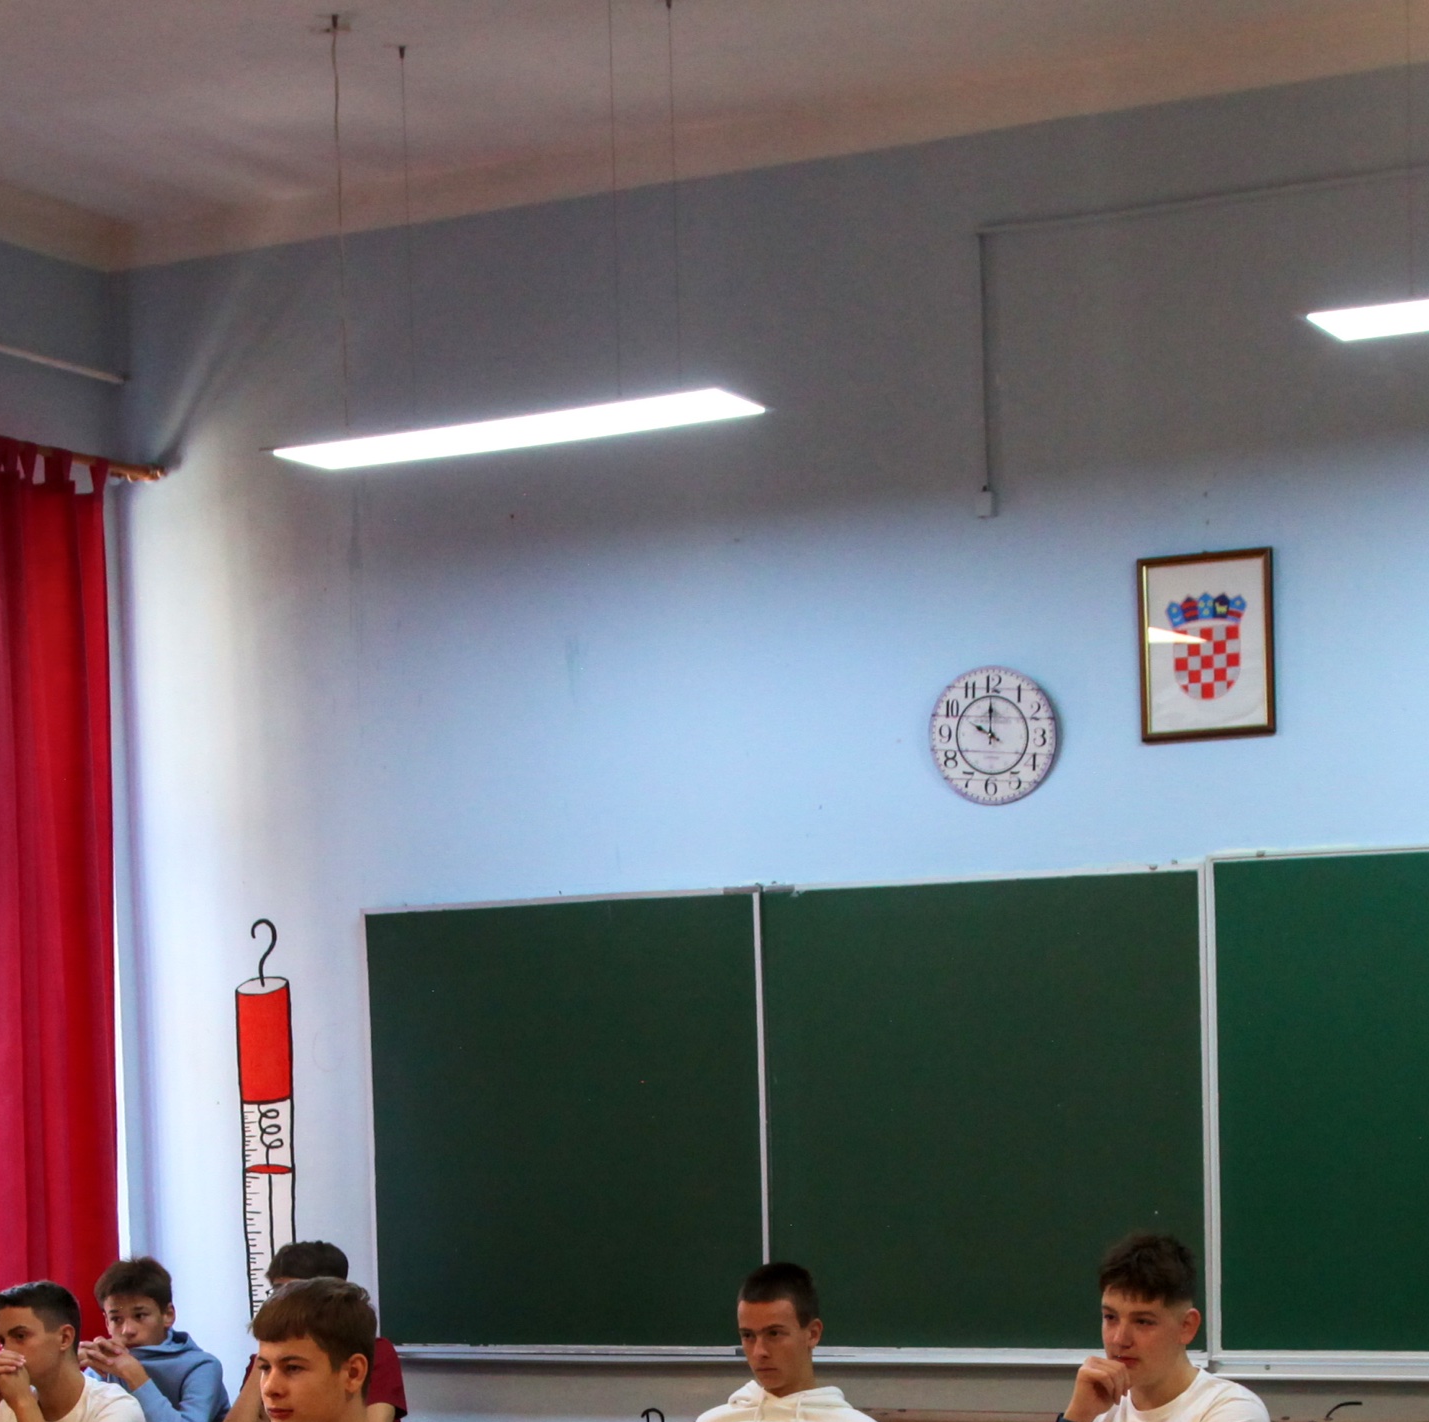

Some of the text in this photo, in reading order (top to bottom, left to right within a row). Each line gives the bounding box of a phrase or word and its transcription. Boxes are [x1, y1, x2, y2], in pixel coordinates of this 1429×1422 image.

[964, 681, 976, 699] 11
[985, 674, 1003, 694] 12
[945, 699, 960, 718] 10
[1029, 702, 1041, 721] 2
[938, 723, 952, 744] 9
[1033, 728, 1047, 747] 3
[943, 749, 958, 769] 8
[1024, 752, 1040, 771] 4
[962, 771, 975, 788] 7
[984, 776, 998, 796] 6
[1008, 771, 1022, 790] 5
